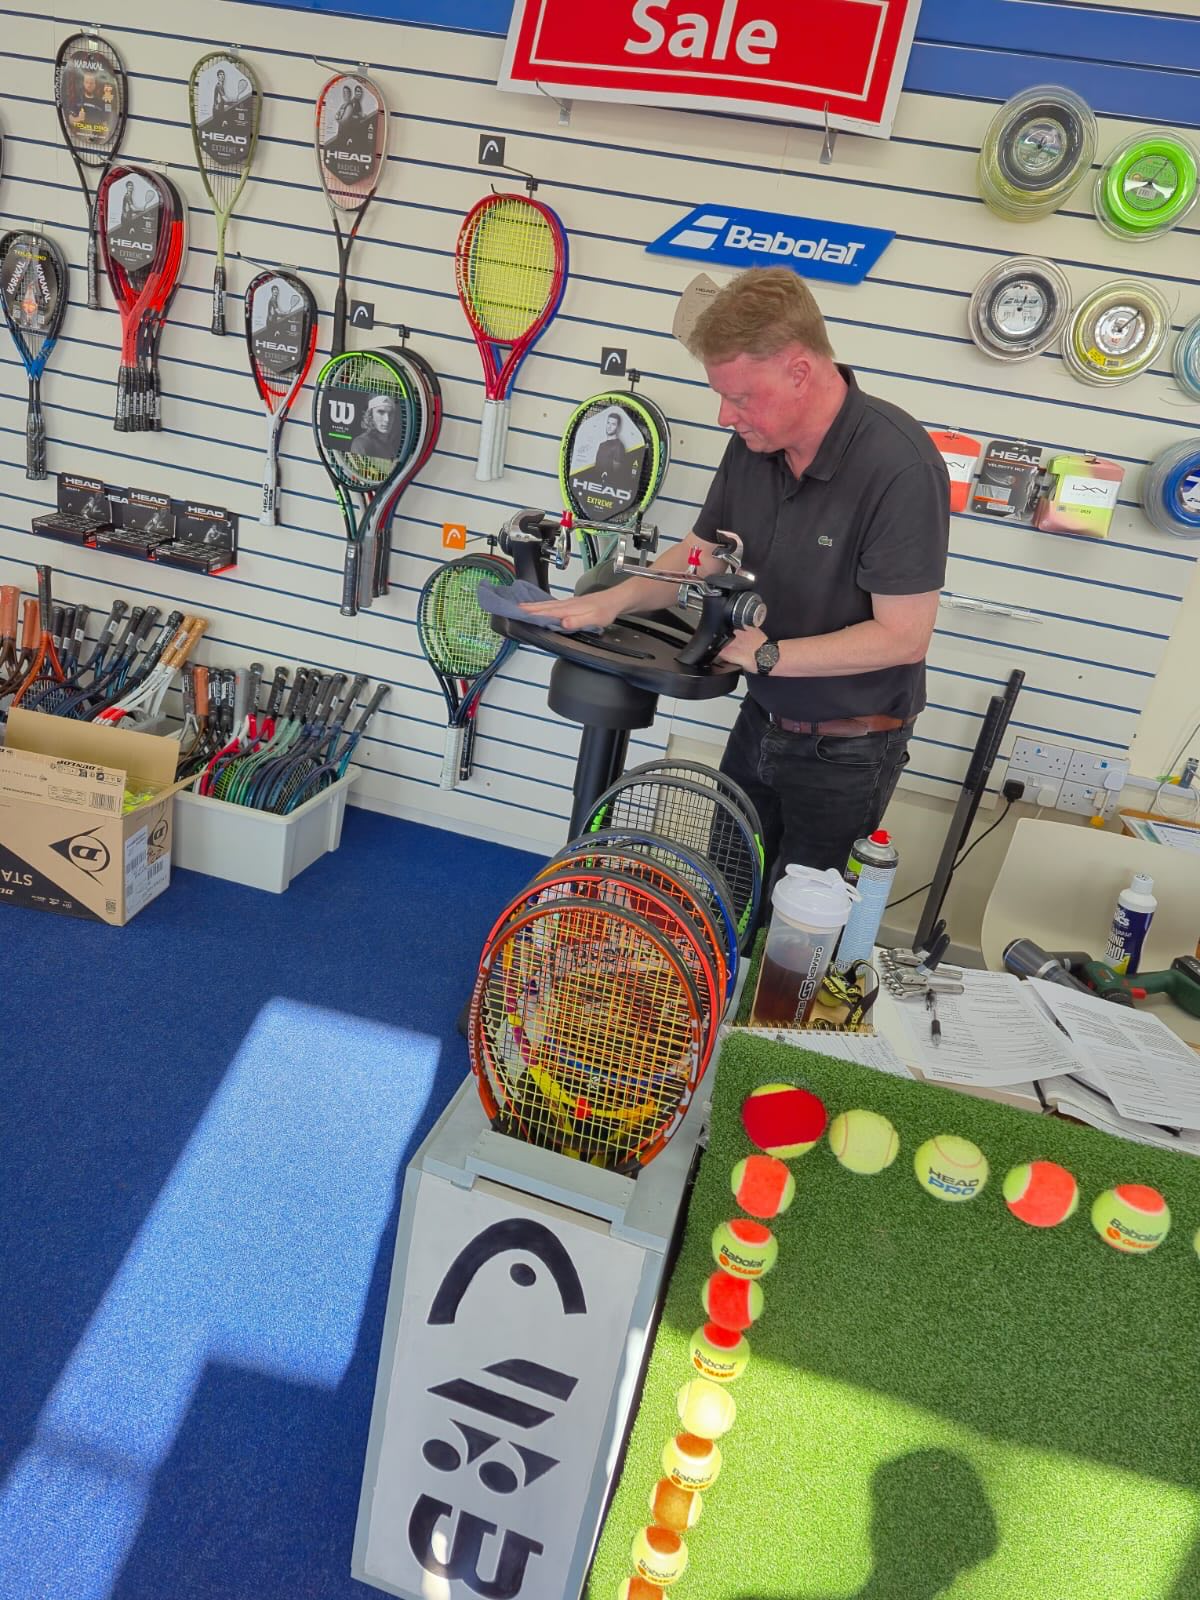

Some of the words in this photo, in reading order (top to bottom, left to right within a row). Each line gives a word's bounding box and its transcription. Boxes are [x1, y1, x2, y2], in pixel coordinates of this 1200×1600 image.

[624, 0, 779, 66] Sale
[74, 60, 105, 71] KARAKAL
[201, 130, 247, 144] HEAD
[326, 150, 372, 163] HEAD
[110, 237, 153, 252] HEAD
[6, 261, 26, 295] KARAKAL
[35, 263, 53, 304] KARAKAL
[255, 339, 298, 354] HEAD
[990, 449, 1041, 465] HEAD
[65, 476, 102, 490] HEAD
[572, 478, 632, 500] HEAD
[131, 492, 168, 506] HEAD
[586, 495, 614, 509] EXTREME
[188, 505, 225, 519] HEAD
[56, 760, 96, 771] DUNLOP
[807, 945, 825, 980] GAMER
[928, 1167, 979, 1187] HEAD
[927, 1177, 976, 1196] PRO
